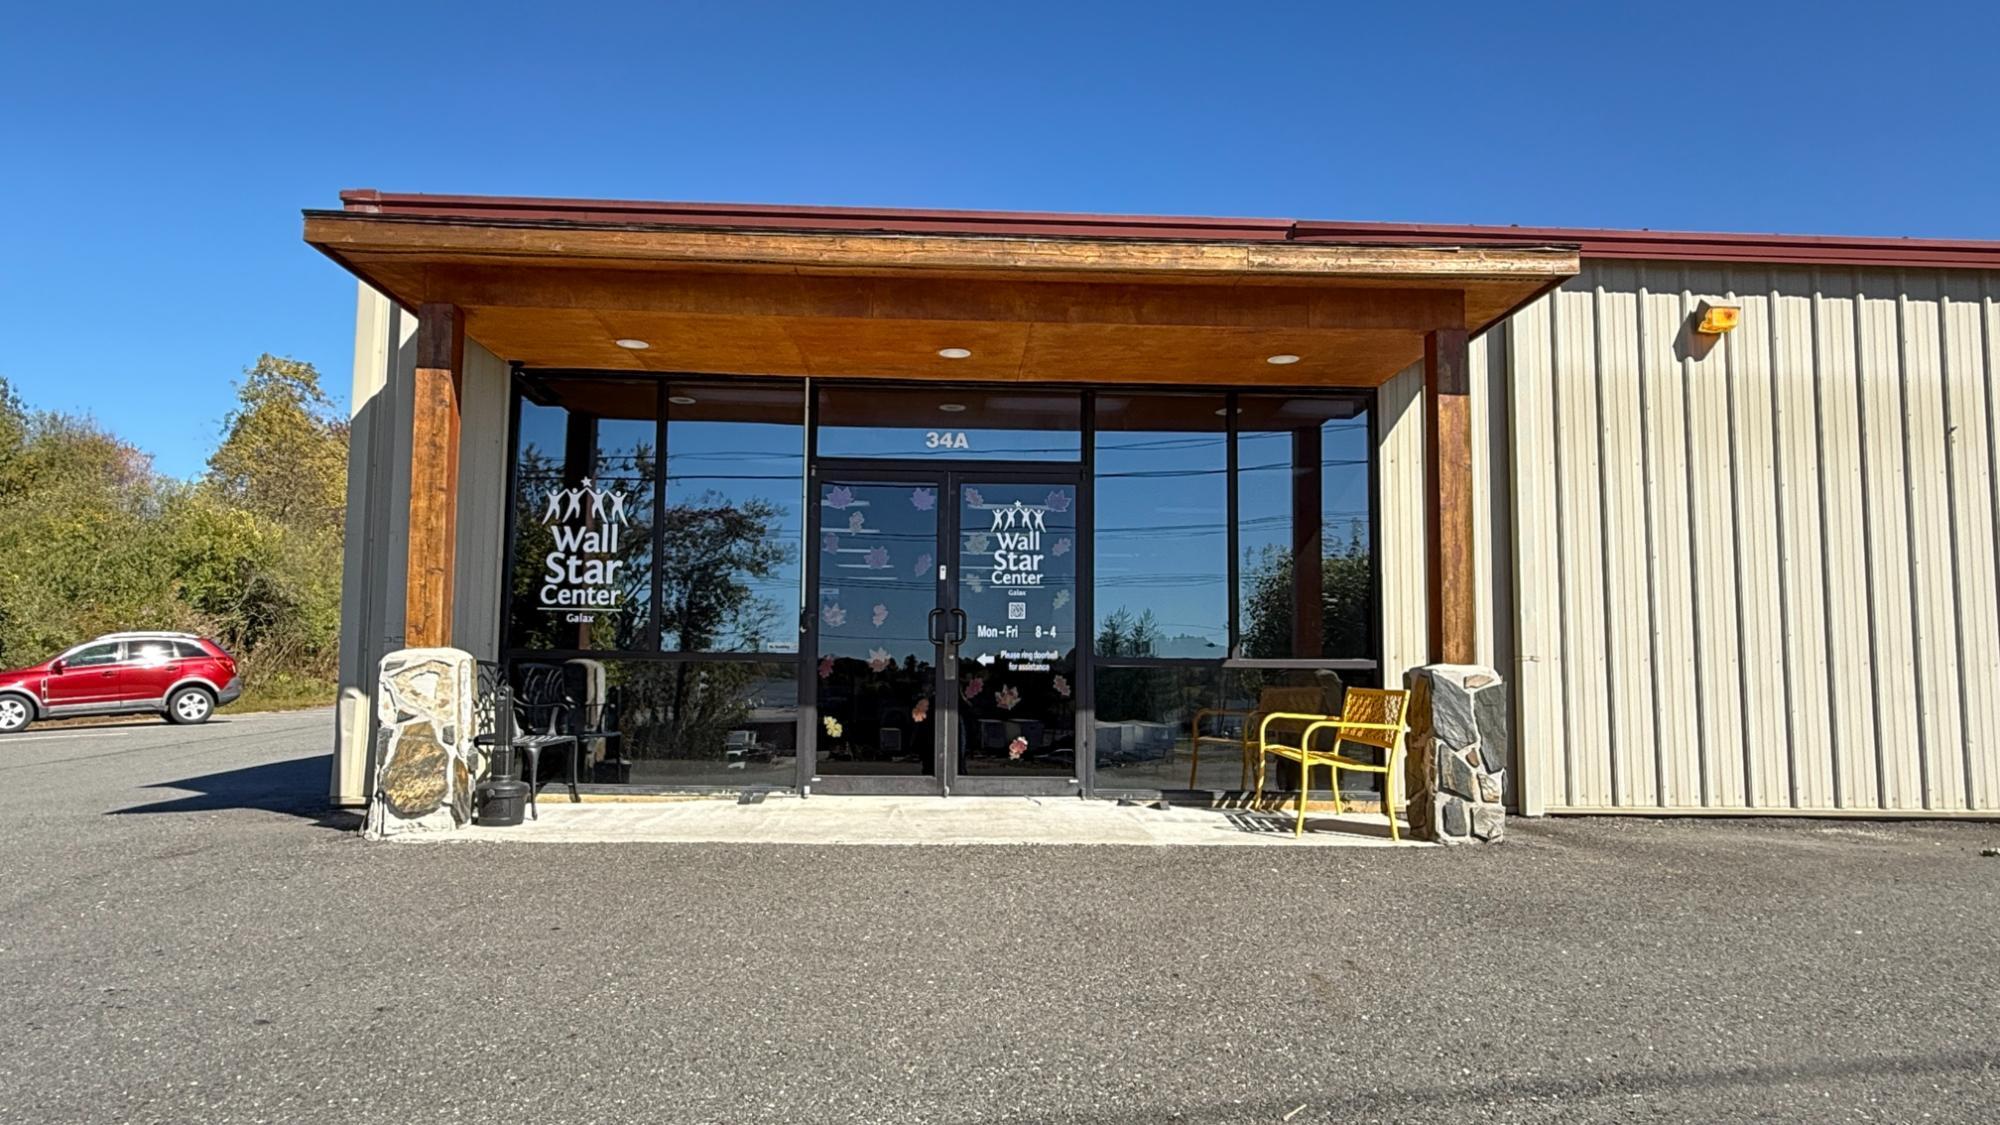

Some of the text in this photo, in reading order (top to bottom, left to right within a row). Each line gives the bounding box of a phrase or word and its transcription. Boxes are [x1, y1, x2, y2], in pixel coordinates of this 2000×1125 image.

[926, 432, 969, 449] 34A
[551, 524, 618, 553] Wall
[996, 531, 1040, 550] Wall
[545, 552, 623, 584] Star
[994, 551, 1044, 571] Star
[992, 571, 1043, 584] Center
[540, 585, 621, 605] Center
[566, 613, 594, 623] Galax
[1000, 650, 1058, 661] Please ring doorbell
[1008, 662, 1050, 671] for assistance
